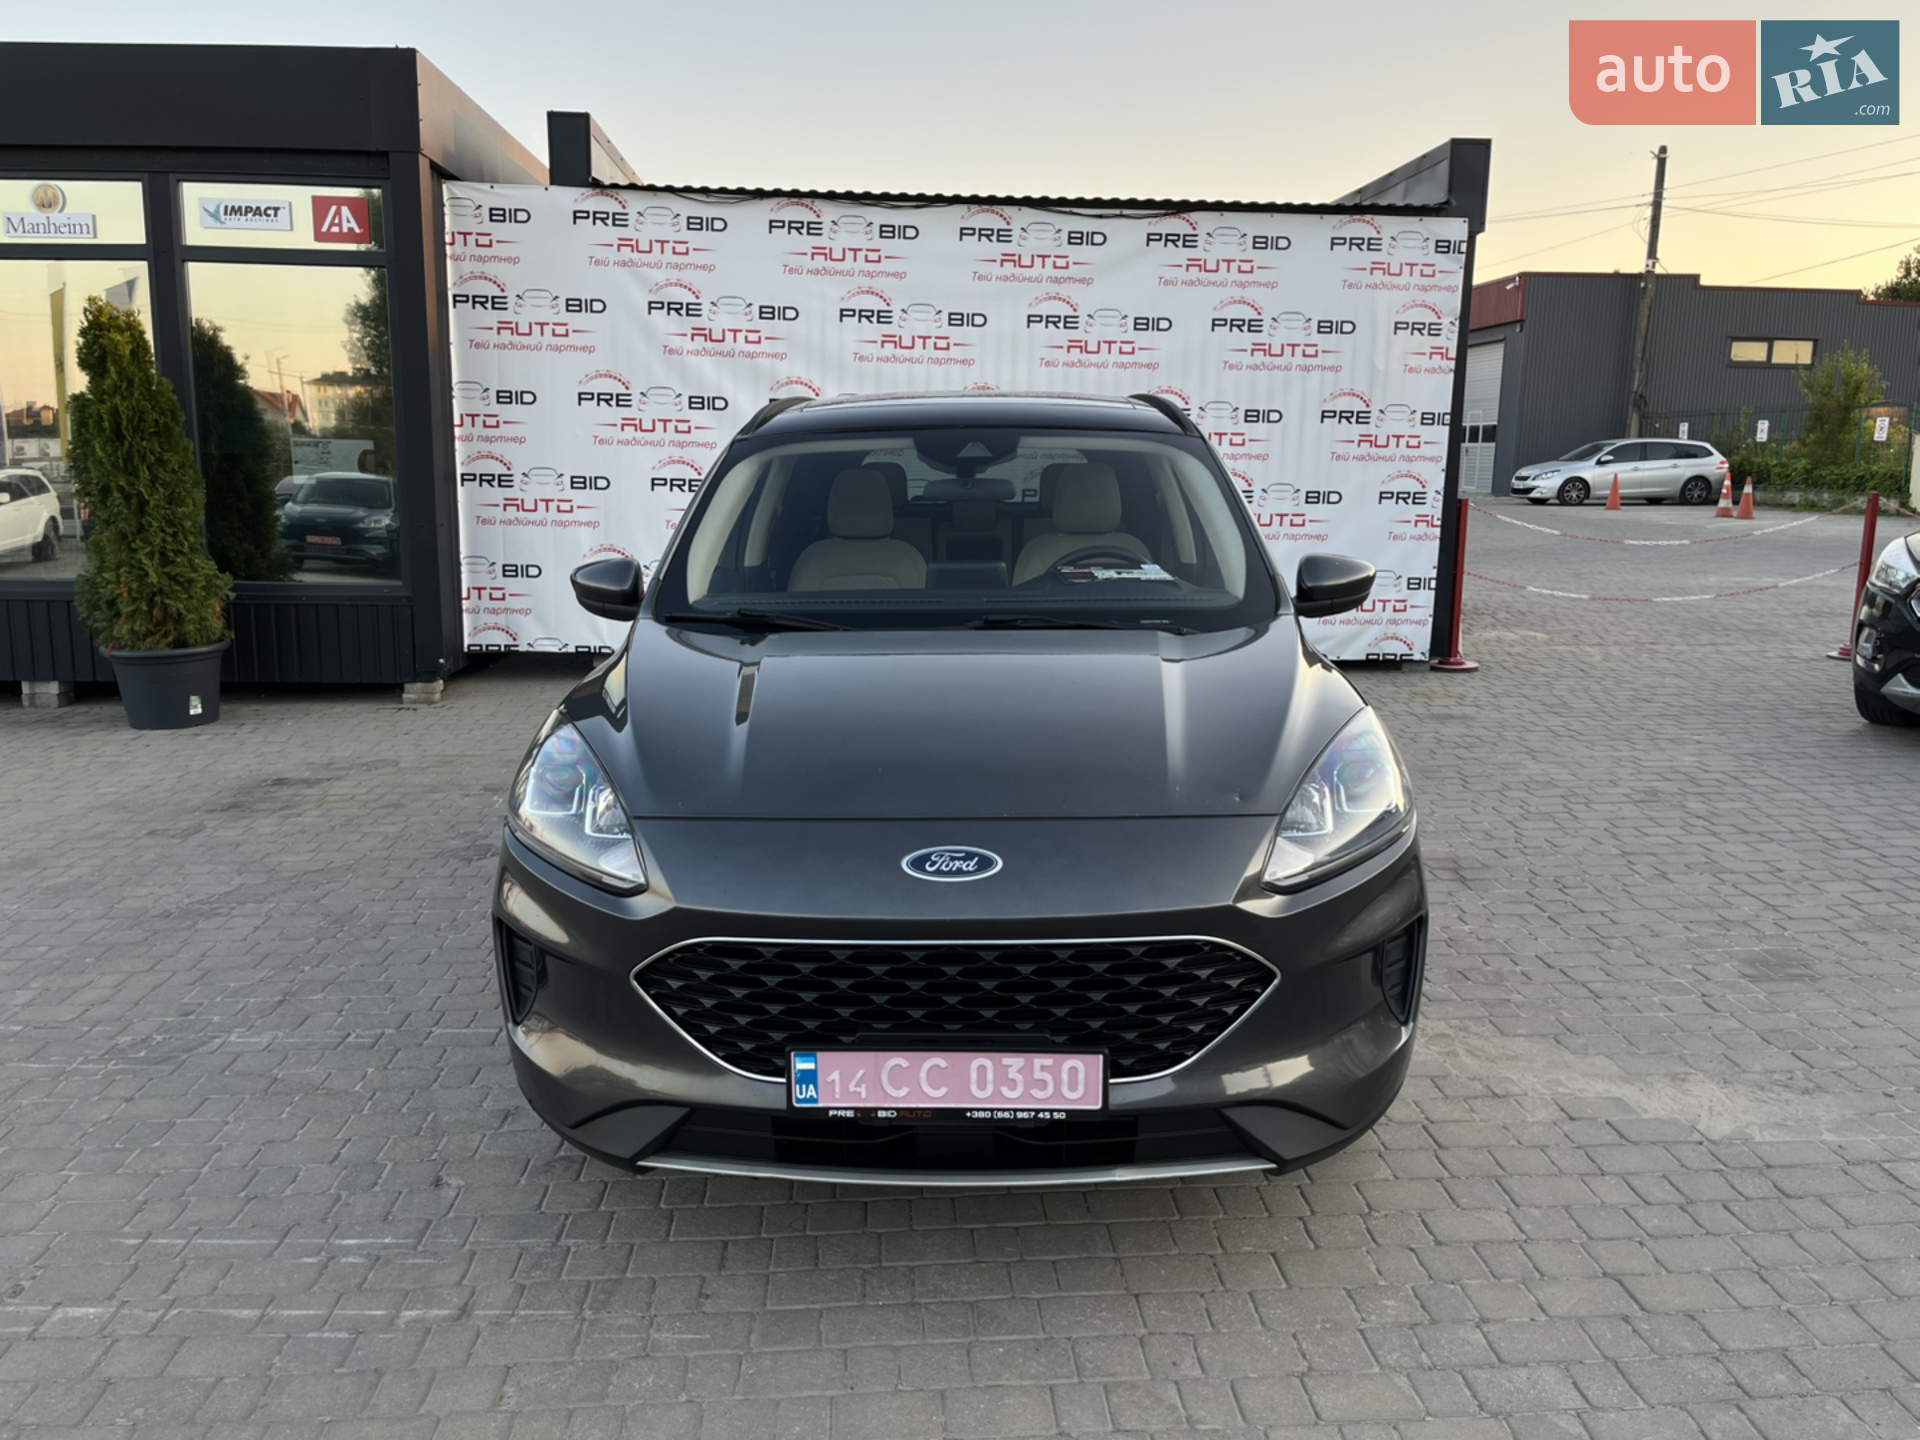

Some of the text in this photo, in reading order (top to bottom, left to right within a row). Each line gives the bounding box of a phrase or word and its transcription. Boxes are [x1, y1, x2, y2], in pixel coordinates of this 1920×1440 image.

[223, 205, 281, 218] IMPACT
[489, 207, 531, 224] BID
[5, 215, 91, 235] Manheim
[573, 209, 728, 233] PRE BID
[769, 219, 919, 240] PRE BID
[960, 226, 1107, 246] PRE BID
[617, 237, 690, 256] AUTO
[1146, 232, 1291, 250] PRE BID
[1331, 236, 1383, 251] PRE
[469, 254, 521, 266] партнер
[811, 246, 882, 264] AUTO
[1000, 253, 1069, 270] AUTO
[588, 256, 716, 273] Твій надійний партнер
[782, 264, 907, 281] Твій надійний партнер
[1186, 258, 1254, 274] AUTO
[1370, 261, 1436, 278] AUTO
[971, 271, 1094, 287] Твій надійний партнер
[1157, 277, 1278, 292] Твій надійний партнер
[1341, 280, 1459, 294] Твій надійний партнер
[452, 293, 607, 314] PRE BID
[648, 300, 799, 321] PRE BID
[839, 308, 987, 328] PRE BID
[1027, 314, 1172, 331] PRE BID
[497, 321, 569, 338] AUTO
[1211, 318, 1356, 335] PRE BID
[1394, 321, 1442, 336] PRE
[690, 327, 762, 345] AUTO
[880, 333, 950, 351] AUTO
[467, 339, 596, 355] Твій надійний партнер
[662, 345, 787, 362] Твій надійний партнер
[1067, 338, 1135, 355] AUTO
[1250, 342, 1318, 358] AUTO
[852, 352, 975, 367] Твій надійний партнер
[1038, 356, 1160, 371] Твій надійний партнер
[1222, 360, 1342, 375] Твій надійний партнер
[1402, 363, 1423, 375] Твій
[496, 389, 537, 405] BID
[578, 391, 729, 411] PRE BID
[1244, 409, 1283, 423] BID
[1320, 410, 1372, 425] PRE
[620, 417, 691, 434] AUTO
[477, 433, 526, 445] партнер
[592, 435, 717, 451] Твій надійний партнер
[1358, 434, 1421, 448] AUTO
[1330, 452, 1443, 464] Твій надійний партнер
[460, 472, 611, 491] PRE BID
[503, 498, 574, 513] AUTO
[1304, 490, 1343, 505] BID
[1378, 491, 1427, 505] PRE
[475, 515, 600, 531] Твій надійний партнер
[1283, 532, 1329, 542] партнер
[1387, 532, 1407, 542] Твій
[502, 563, 543, 579] BID
[483, 606, 532, 617] партнер
[1339, 617, 1383, 627] надійний
[1385, 618, 1430, 628] партнер
[925, 851, 979, 872] Ford
[825, 1057, 1086, 1100] 14 CC 0350
[795, 1084, 817, 1099] UA
[828, 1109, 855, 1118] PRE
[965, 1111, 991, 1119] +380
